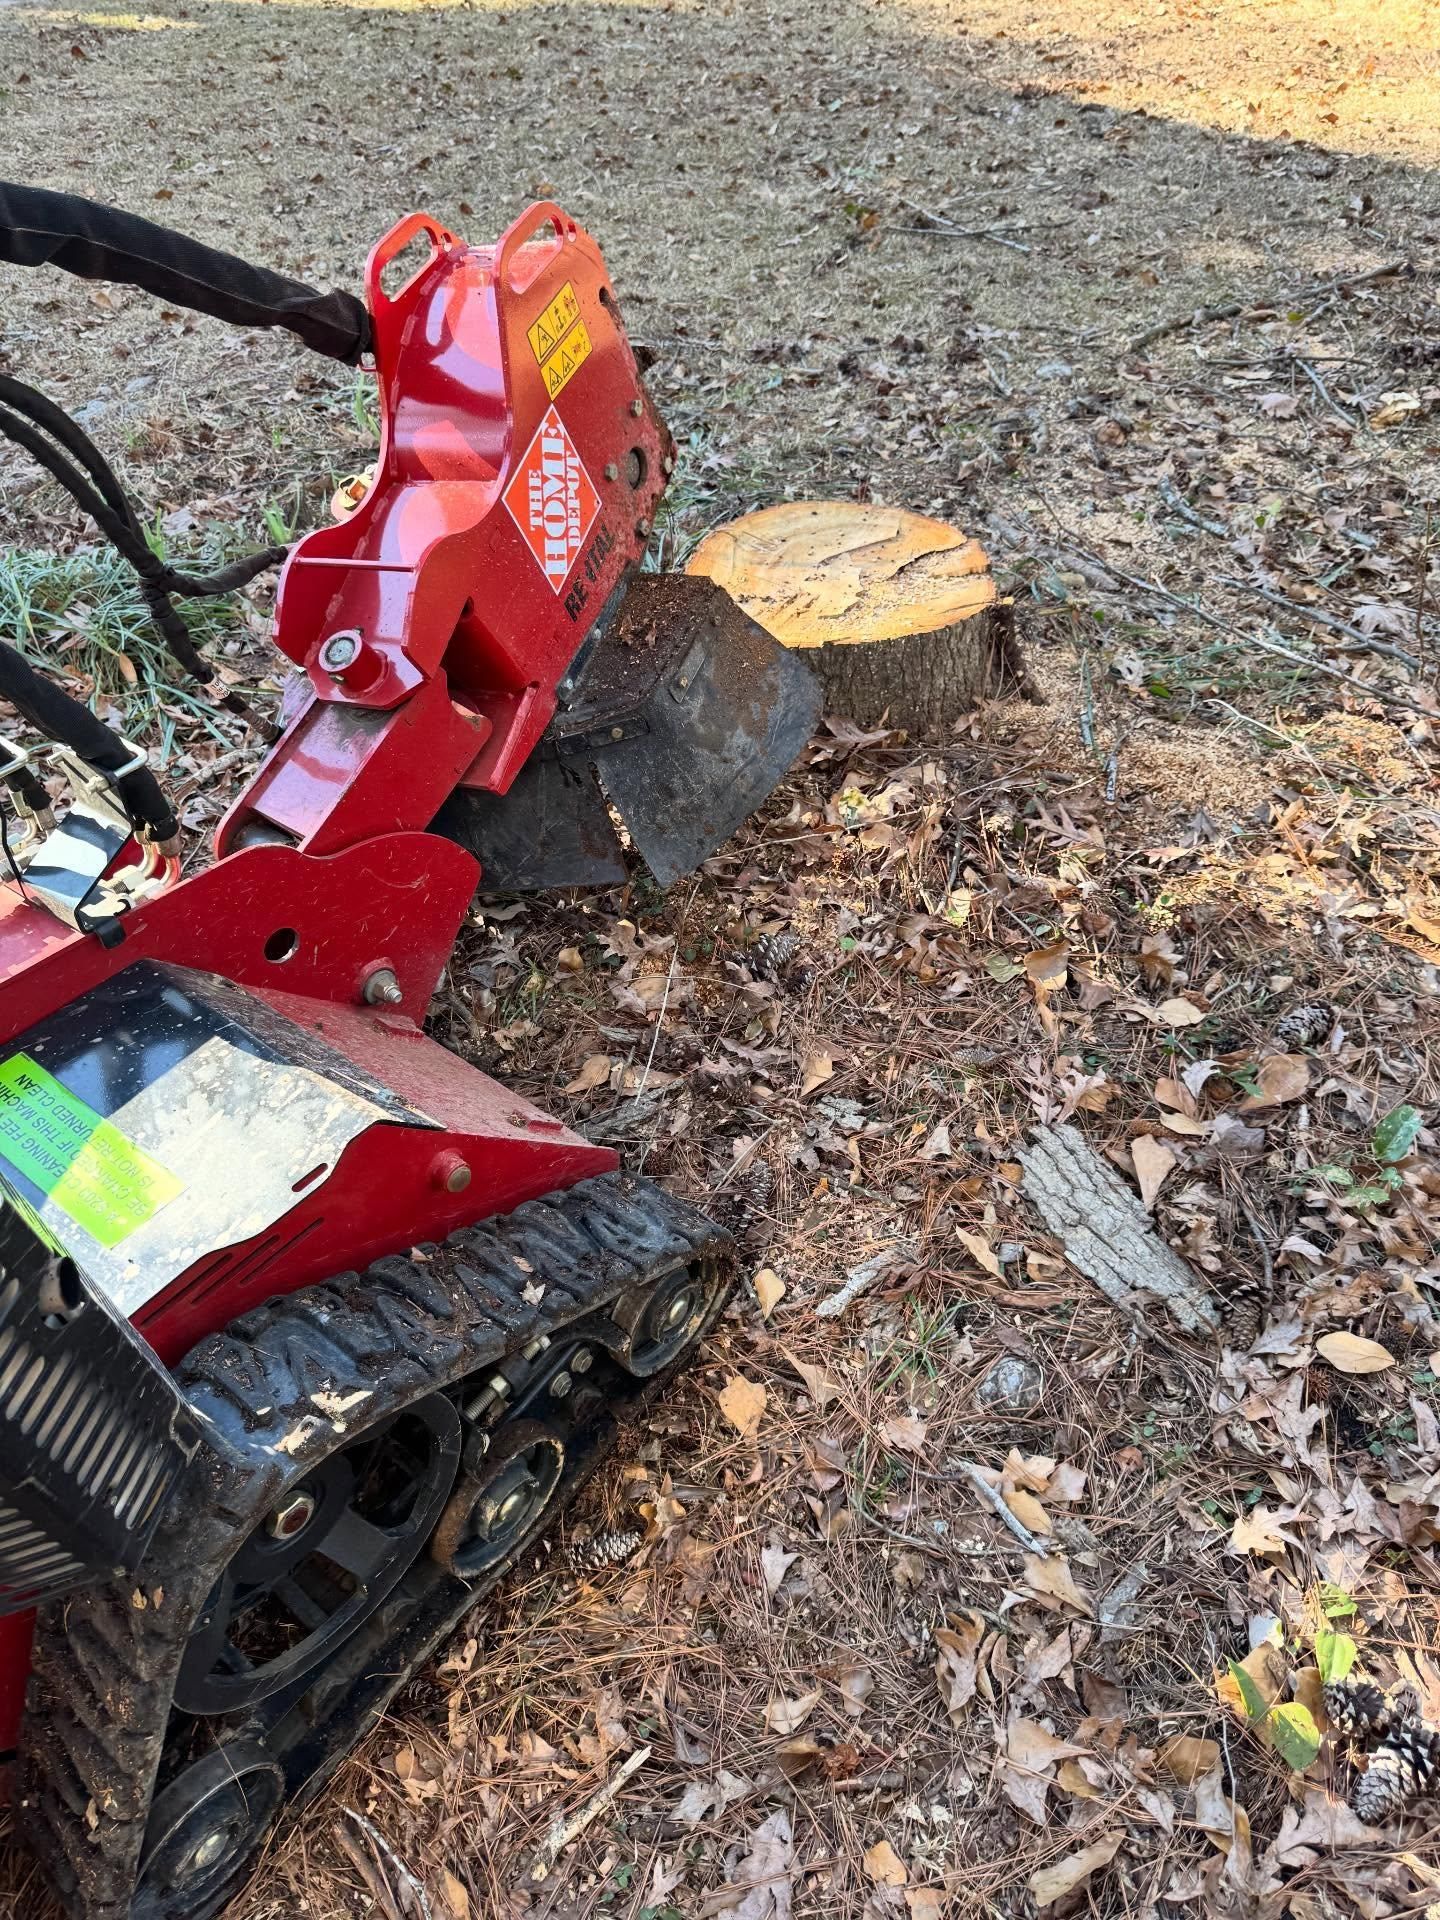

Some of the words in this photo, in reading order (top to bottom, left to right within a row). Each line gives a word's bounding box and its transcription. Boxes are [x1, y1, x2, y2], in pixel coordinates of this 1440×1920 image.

[528, 469, 543, 531] THE
[541, 422, 568, 577] HOME
[566, 451, 581, 549] DEPOT
[14, 1073, 54, 1107] CLEAN
[1, 1119, 26, 1141] FEE
[31, 1118, 61, 1143] THIS
[51, 1103, 114, 1157] RETURNED
[55, 1138, 75, 1153] IF
[20, 1138, 80, 1190] CLEANING
[110, 1154, 140, 1177] NOT
